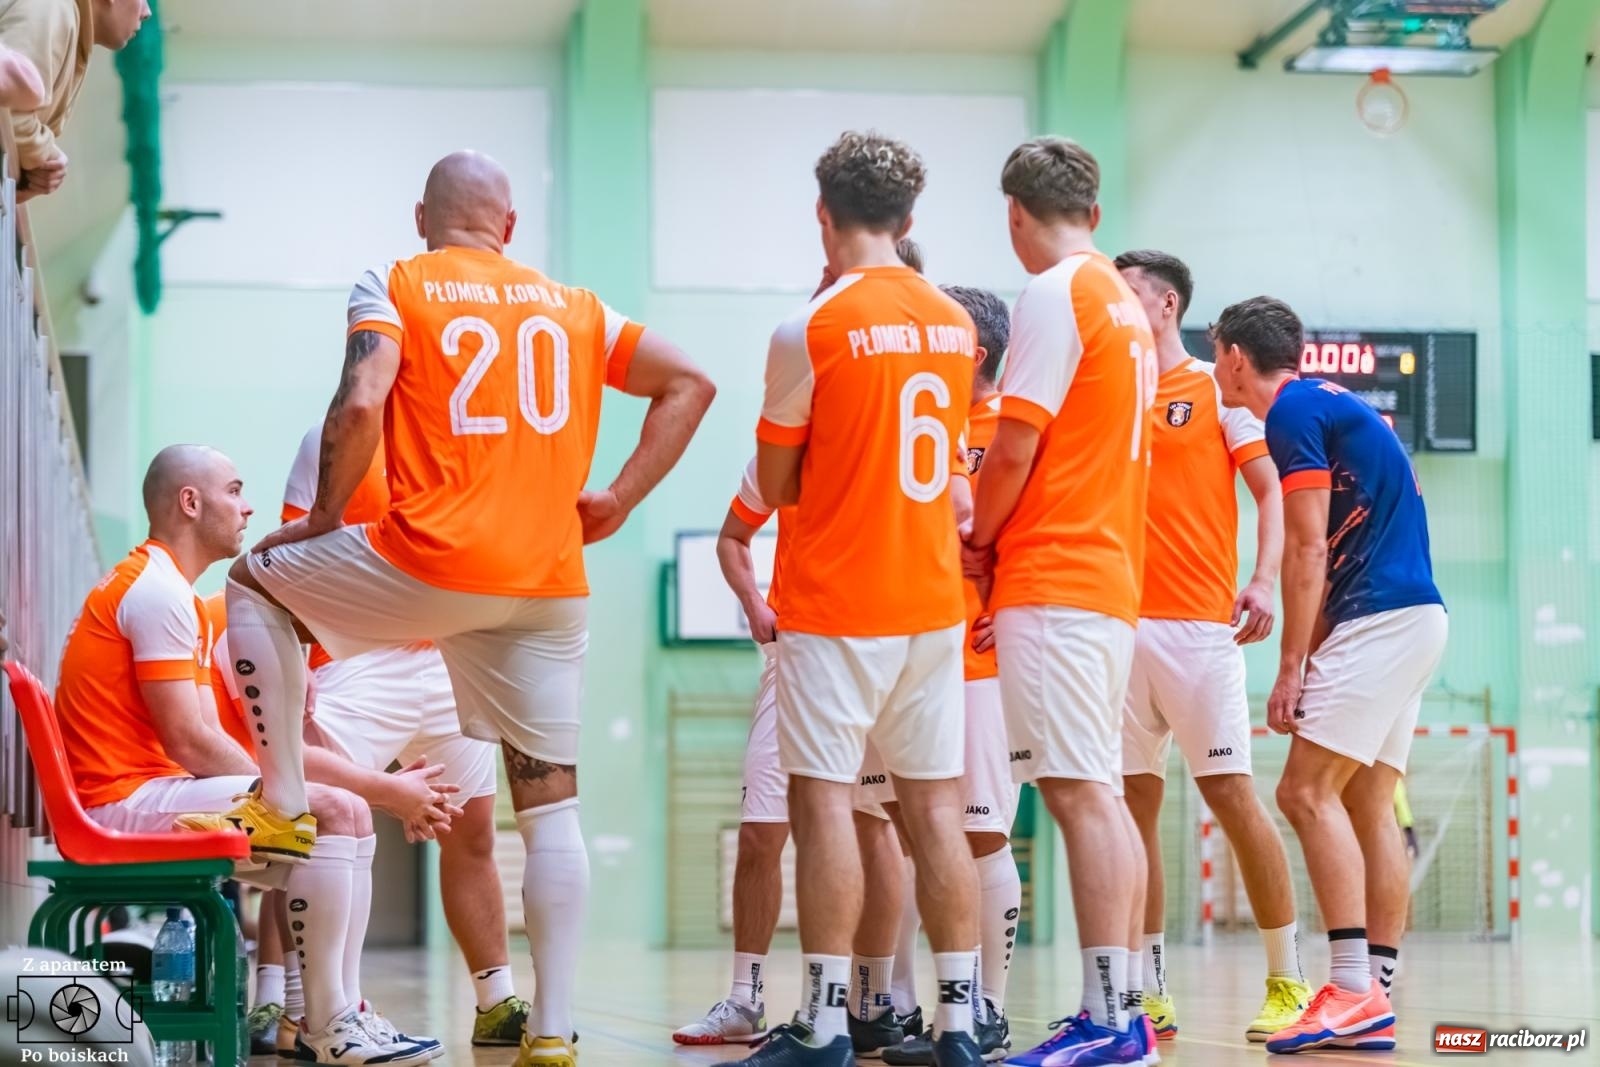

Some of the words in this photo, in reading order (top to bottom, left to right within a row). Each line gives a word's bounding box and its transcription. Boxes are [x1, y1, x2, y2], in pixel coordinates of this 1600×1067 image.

[423, 280, 500, 305] PŁOMIEŃ
[848, 320, 922, 359] PŁOMIEŃ
[926, 325, 975, 358] KOBYL
[441, 315, 570, 436] 20
[899, 371, 951, 503] 6
[262, 551, 271, 568] KO
[1009, 749, 1032, 763] JAKO
[1208, 747, 1233, 758] JAKO
[861, 774, 886, 786] JAKO
[965, 805, 990, 815] JAKO
[830, 984, 847, 1006] F
